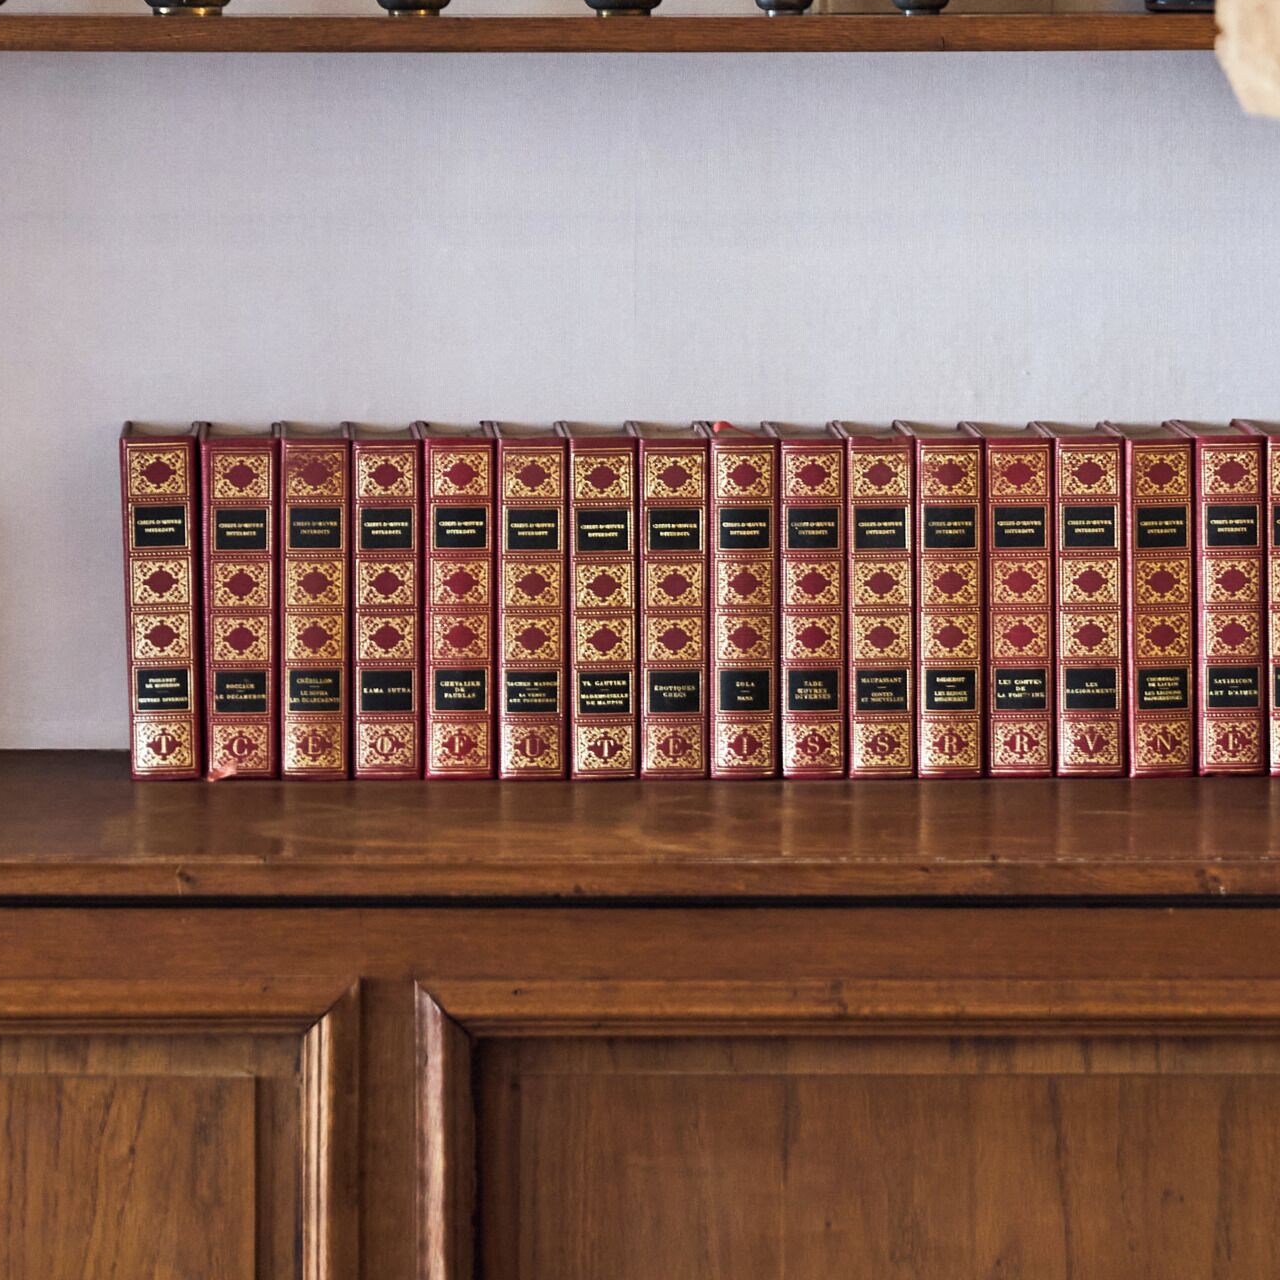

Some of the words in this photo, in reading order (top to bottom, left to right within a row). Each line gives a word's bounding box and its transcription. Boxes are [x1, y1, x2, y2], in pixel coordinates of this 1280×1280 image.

[155, 735, 171, 755] T
[232, 737, 249, 757] C
[307, 735, 322, 755] E
[453, 735, 466, 754] F
[524, 736, 540, 757] U
[596, 739, 614, 757] T
[669, 736, 683, 756] E
[806, 736, 821, 754] S
[875, 734, 890, 753] S
[944, 734, 959, 754] R
[1015, 733, 1030, 752] R
[1083, 734, 1099, 752] V
[1156, 734, 1172, 751] N
[1228, 733, 1243, 751] E
